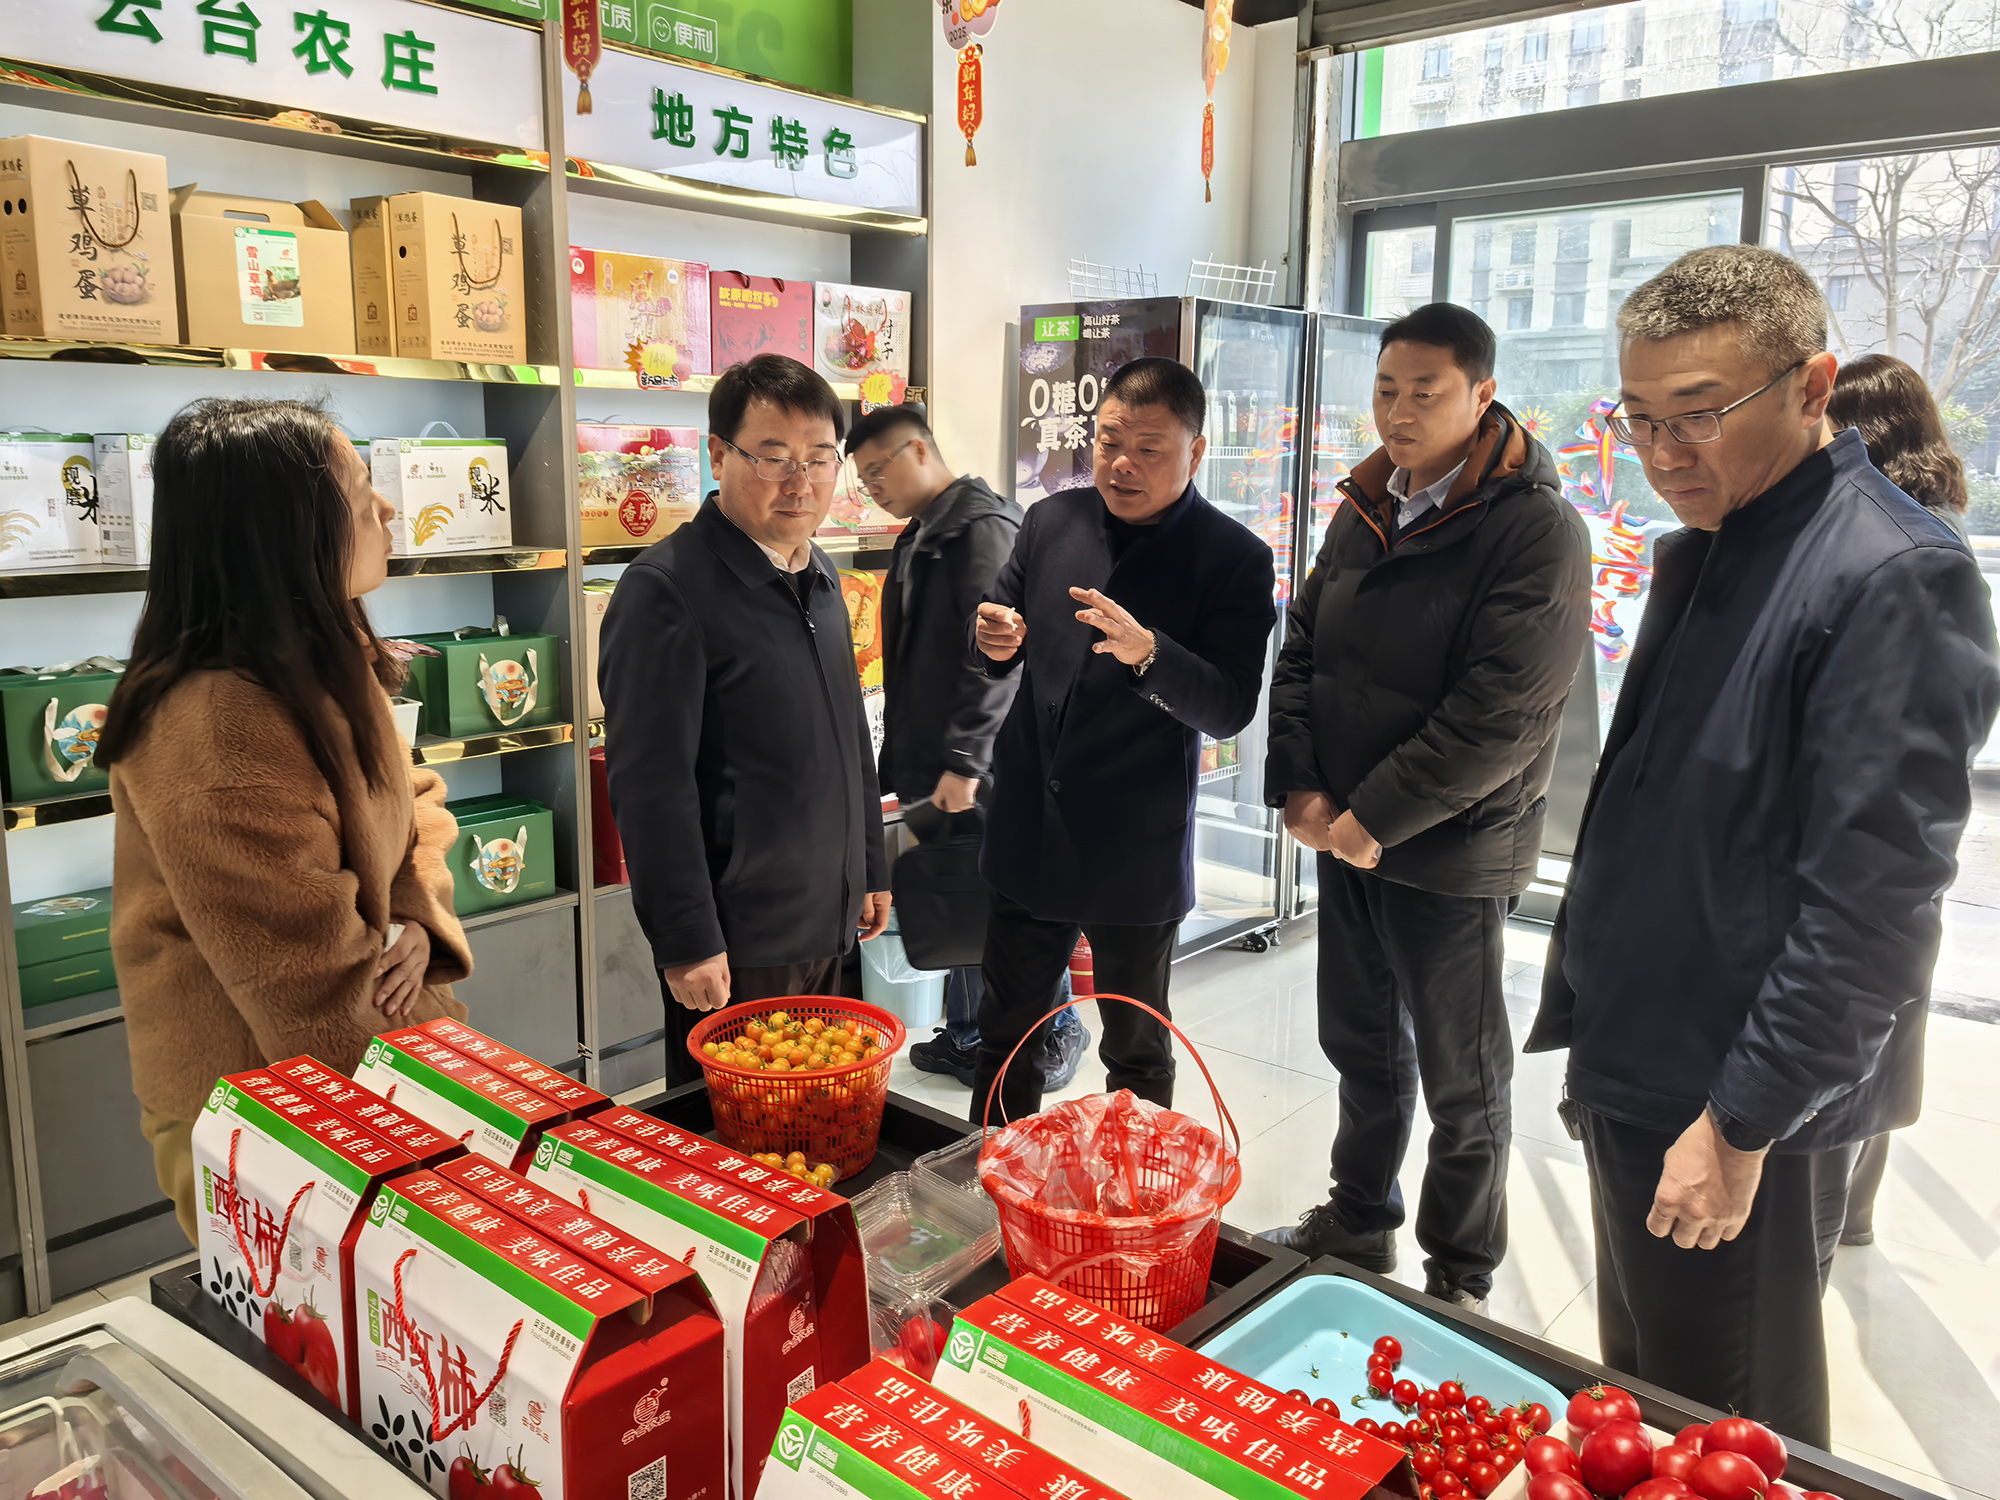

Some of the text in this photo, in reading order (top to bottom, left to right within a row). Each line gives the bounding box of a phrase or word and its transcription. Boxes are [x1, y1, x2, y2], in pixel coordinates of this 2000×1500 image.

[95, 0, 439, 95] 云台农庄
[571, 0, 592, 56] 年好
[673, 21, 713, 53] 便利
[949, 27, 968, 43] 2025
[651, 87, 859, 180] 地方特色
[962, 64, 976, 122] 新年好
[66, 185, 103, 300] 草鸡蛋
[246, 245, 264, 298] 雪山草鸡
[450, 233, 475, 329] 草鸡蛋
[1041, 321, 1070, 337] 让茶
[1082, 328, 1111, 339] 喝让茶
[1083, 314, 1120, 326] 高山好茶
[1029, 374, 1109, 417] 0糖0
[1036, 414, 1097, 452] 真茶
[622, 502, 656, 522] 香肠
[285, 1064, 364, 1103] 美味佳品
[355, 1103, 440, 1149] 营养健康
[394, 1033, 470, 1071] 营养健康
[463, 1071, 546, 1113] 美味佳品
[432, 1024, 508, 1060] 美味佳品
[503, 1060, 587, 1100] 营养健康
[240, 1075, 317, 1116] 营养健康
[306, 1116, 392, 1164] 美味佳品
[611, 1114, 823, 1206] 美味佳品 营养健康
[567, 1127, 666, 1174] 营养健康
[665, 1172, 777, 1224] 美味佳品
[212, 1172, 282, 1274] 西红柿
[406, 1179, 505, 1234] 营养健康
[501, 1236, 612, 1299] 美味佳品
[462, 1164, 562, 1217] 美味佳品
[557, 1216, 670, 1279] 营养健康
[380, 1296, 478, 1431] 西红柿
[989, 1312, 1329, 1491] 营养健康 美味佳品
[1029, 1287, 1366, 1459] 美味佳品 营养健康
[823, 1401, 981, 1497] 营养健康
[875, 1377, 1028, 1469] 美味佳品
